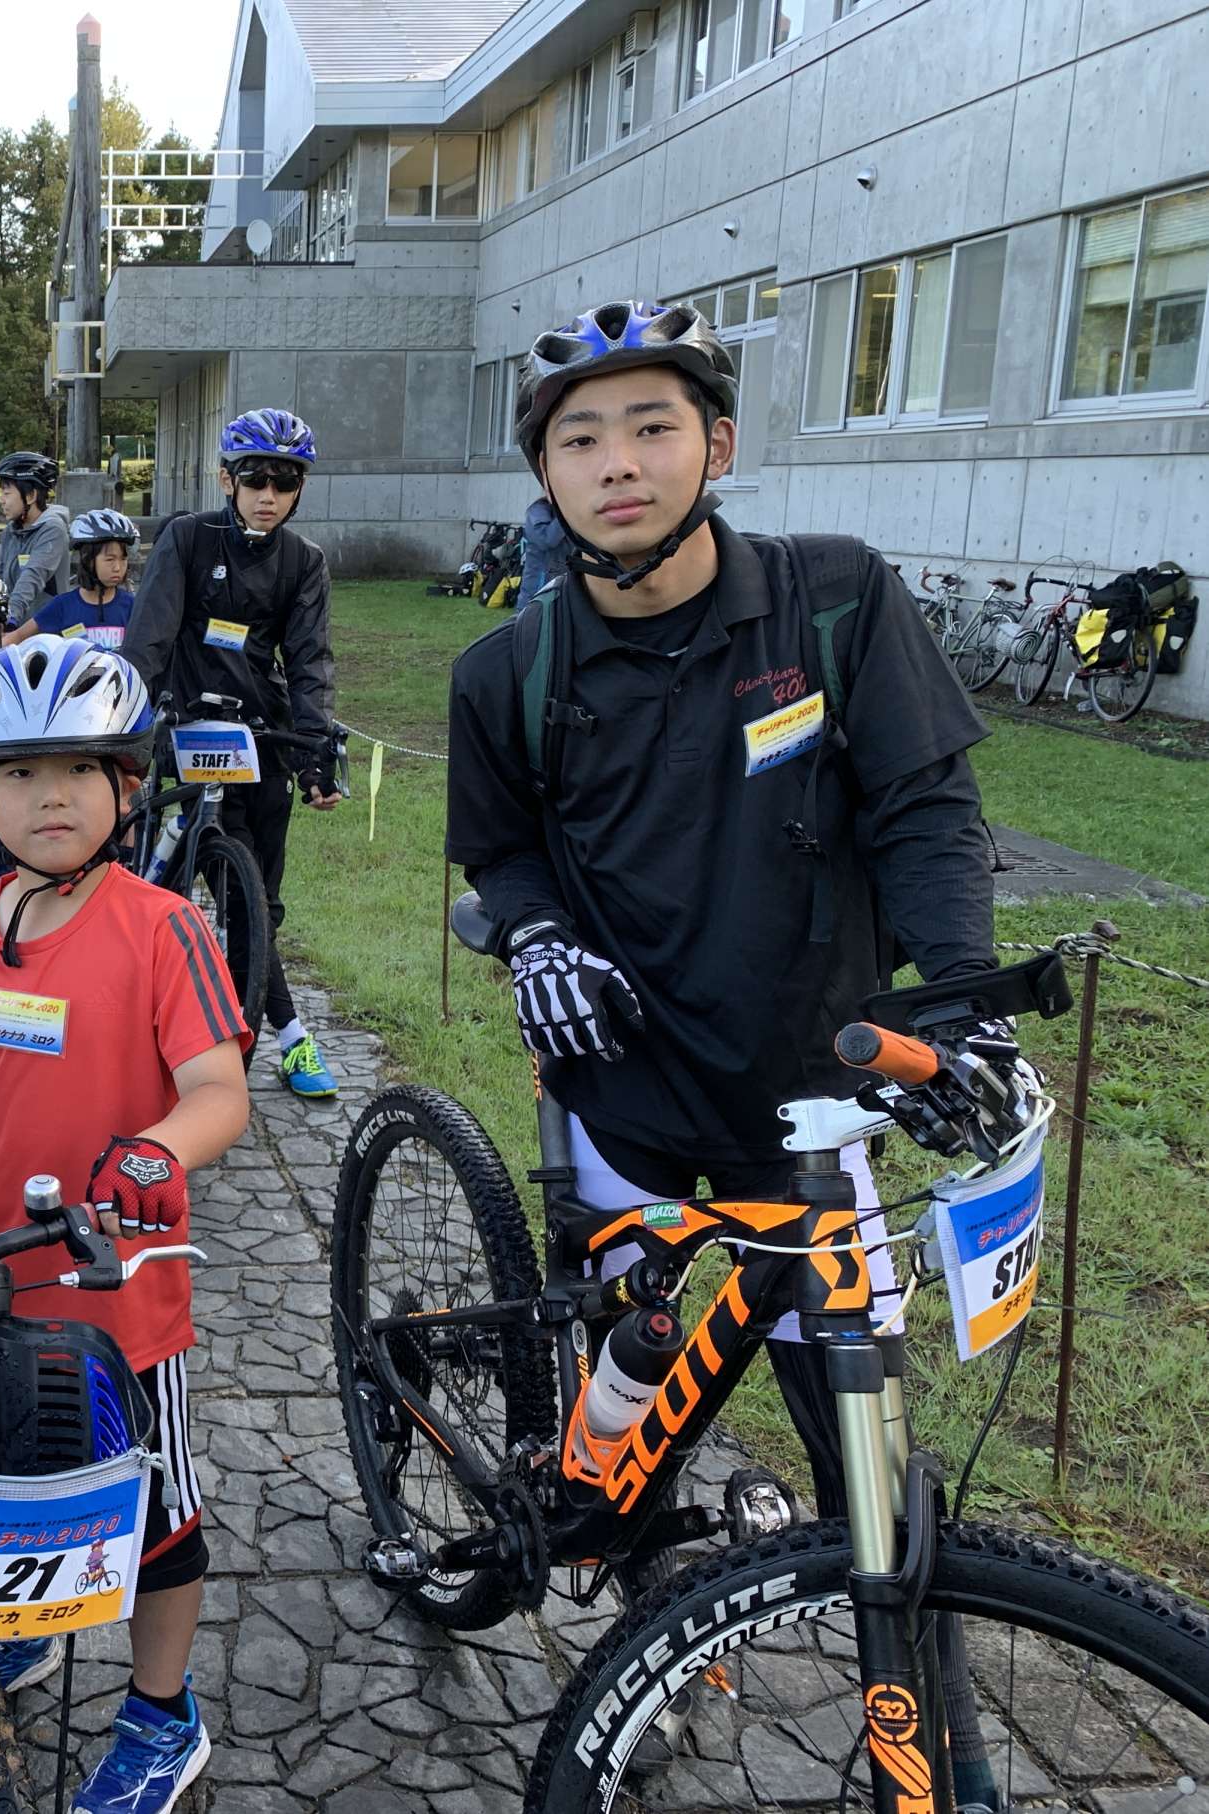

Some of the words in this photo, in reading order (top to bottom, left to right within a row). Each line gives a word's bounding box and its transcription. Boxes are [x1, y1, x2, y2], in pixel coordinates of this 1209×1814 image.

[87, 627, 125, 647] ARVEL
[797, 702, 818, 719] 2020
[192, 753, 231, 768] STAFF
[36, 1003, 60, 1014] 2020
[30, 1033, 56, 1046] ミロク
[355, 1111, 388, 1159] RACE
[643, 1205, 683, 1222] AMAZON
[992, 1218, 1040, 1300] STA
[605, 1264, 750, 1514] SCOTT
[36, 1602, 84, 1622] ミロク
[574, 1632, 674, 1769] RACE
[682, 1572, 797, 1644] LITE
[875, 1700, 908, 1720] 32
